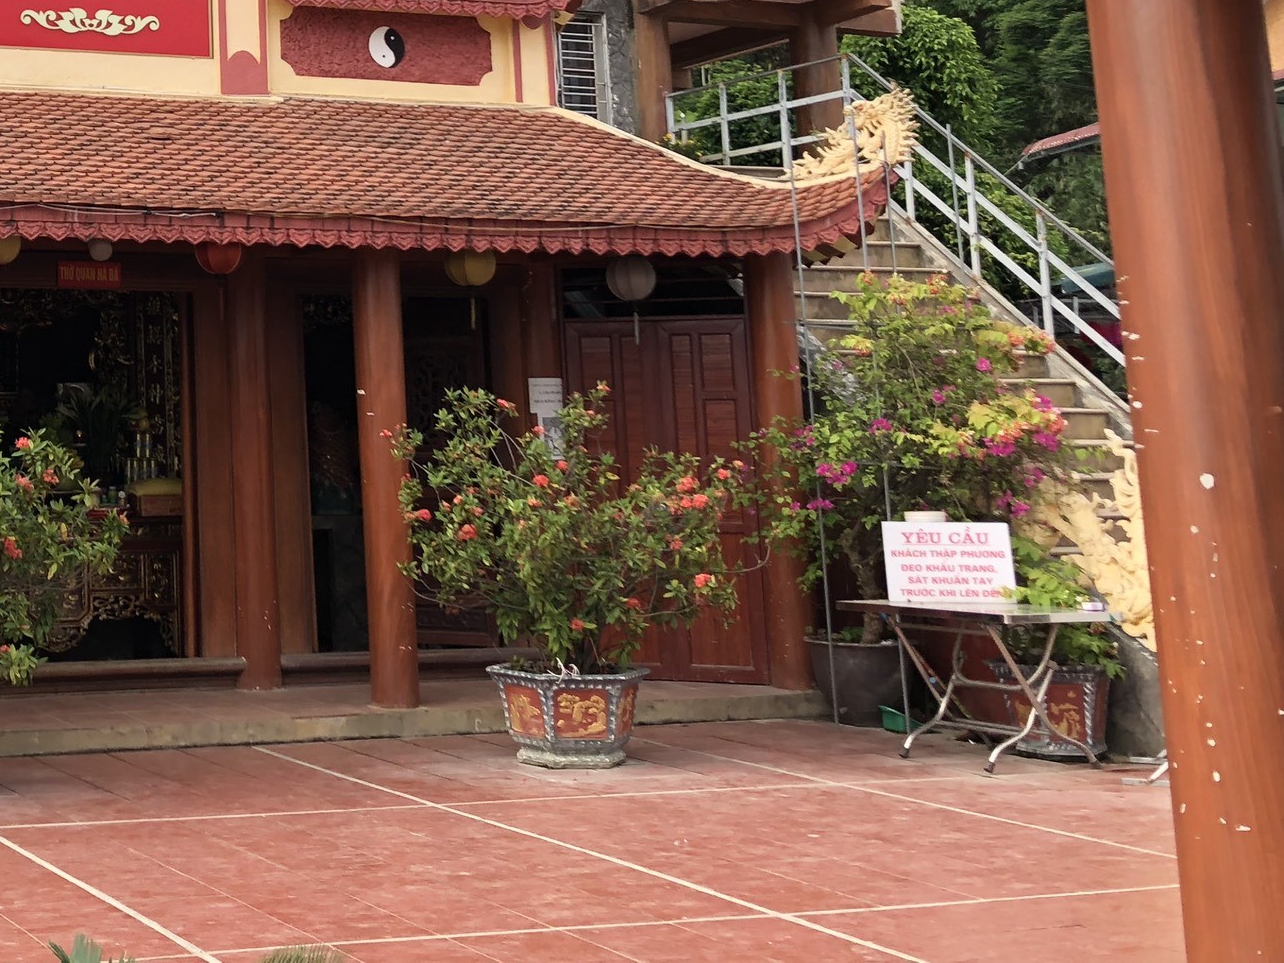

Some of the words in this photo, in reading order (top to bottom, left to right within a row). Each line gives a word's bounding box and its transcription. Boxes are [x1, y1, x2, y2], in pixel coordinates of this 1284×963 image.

[901, 528, 942, 544] YÊU
[948, 526, 989, 544] CẦU
[891, 548, 927, 558] KHÁCH
[960, 549, 1006, 559] PHƯƠNG
[901, 564, 923, 573] ĐEO
[907, 575, 929, 585] SÁT
[972, 577, 994, 586] TAY
[939, 589, 957, 597] KHI
[959, 588, 980, 598] LÊN
